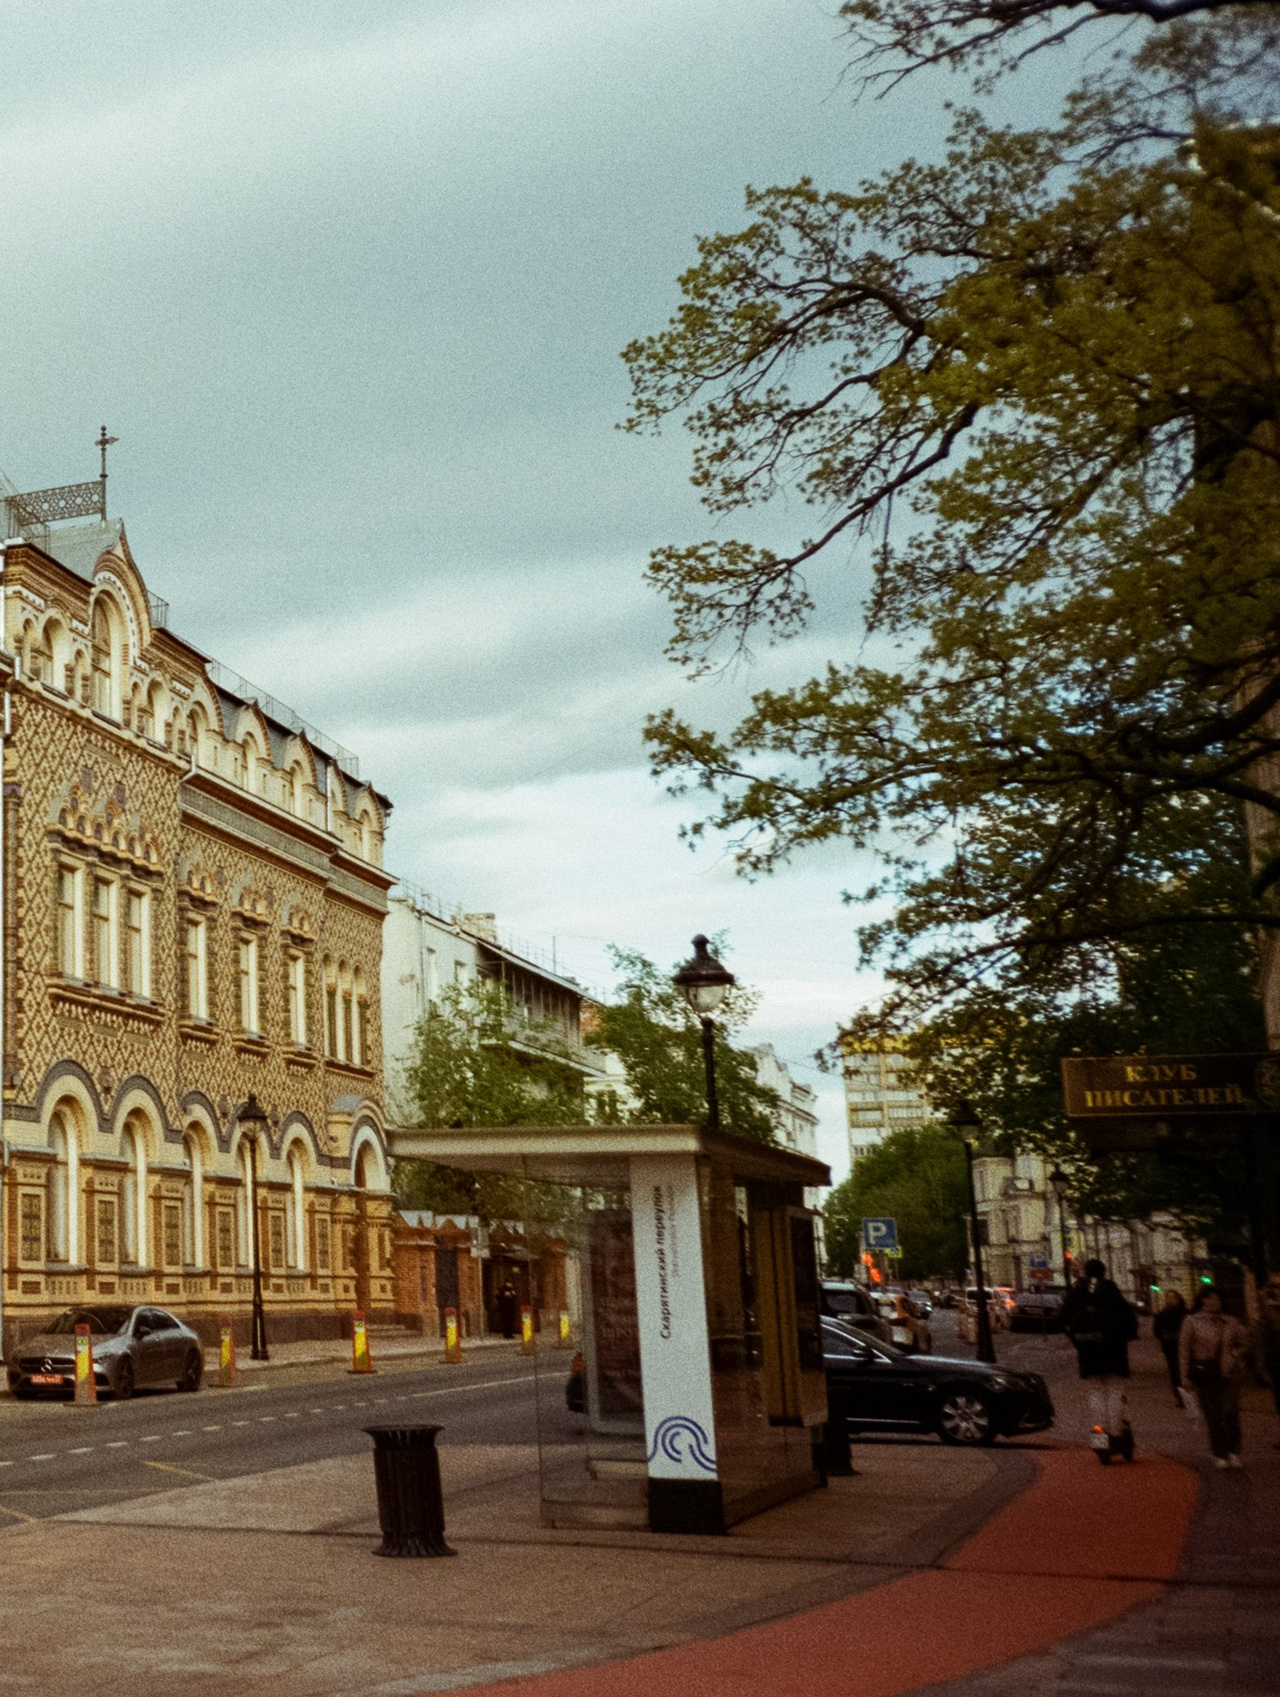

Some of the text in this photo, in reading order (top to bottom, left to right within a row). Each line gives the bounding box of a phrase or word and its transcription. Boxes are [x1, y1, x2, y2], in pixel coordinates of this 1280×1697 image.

[1125, 1064, 1198, 1083] КЛУБ
[1084, 1084, 1243, 1107] ПИСАТЕЛЕЙ
[867, 1222, 888, 1245] P
[653, 1186, 672, 1340] Скарятинский переулок
